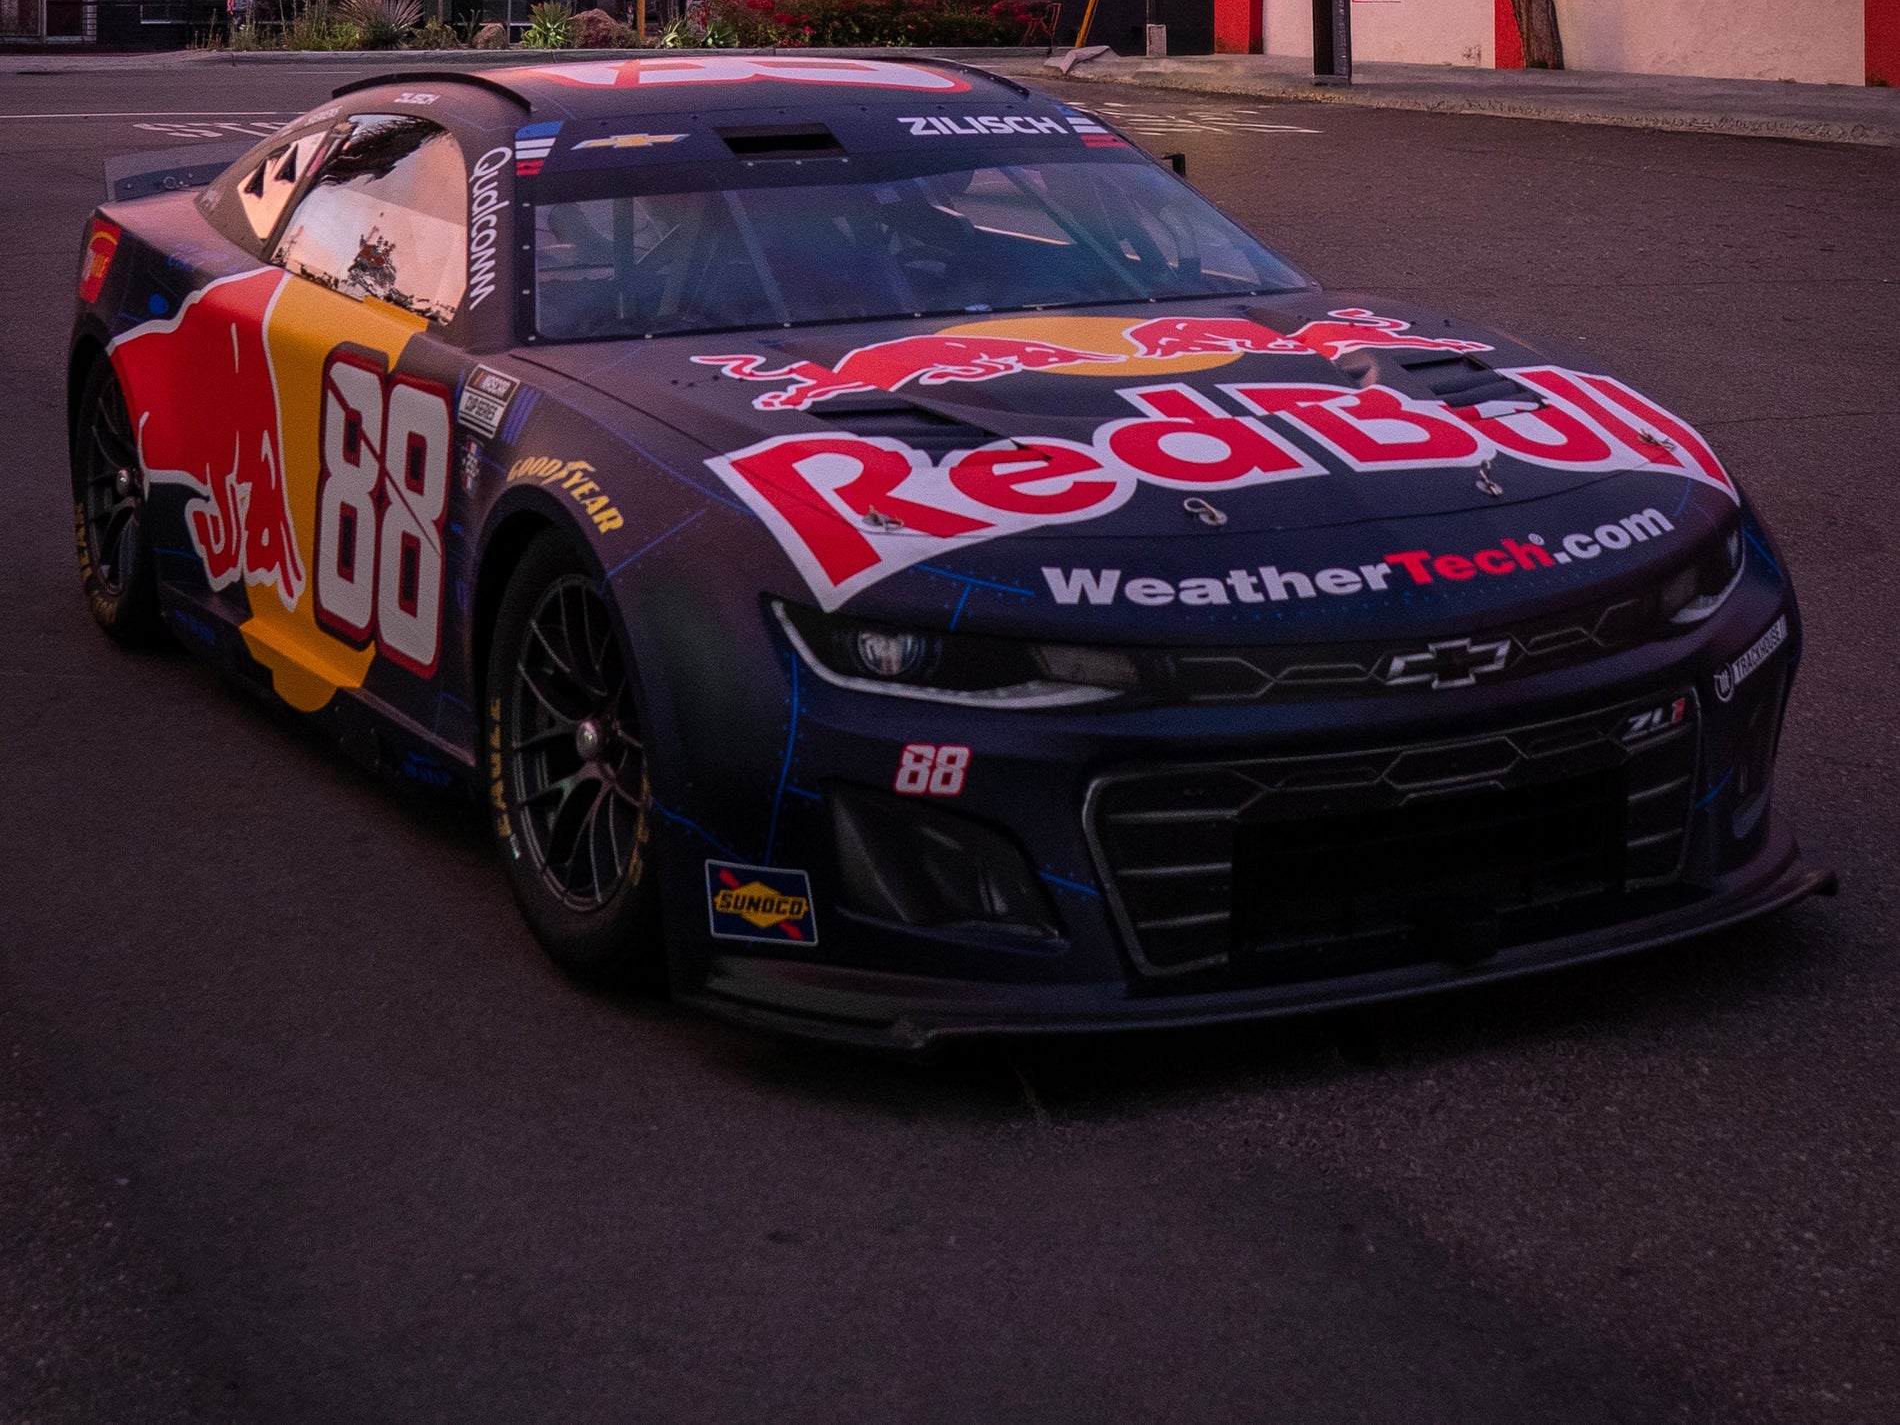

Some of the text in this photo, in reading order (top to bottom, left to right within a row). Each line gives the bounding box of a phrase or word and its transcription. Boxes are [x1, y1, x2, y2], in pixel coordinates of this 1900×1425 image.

[896, 115, 1070, 136] ZILISCH
[468, 146, 513, 311] Qualcomm
[315, 345, 454, 678] 88
[506, 456, 624, 533] GOODYEAR
[722, 366, 1737, 601] Red Bull
[1622, 696, 1686, 742] ZL1
[894, 742, 972, 796] 88
[719, 892, 803, 916] SUNOCO
